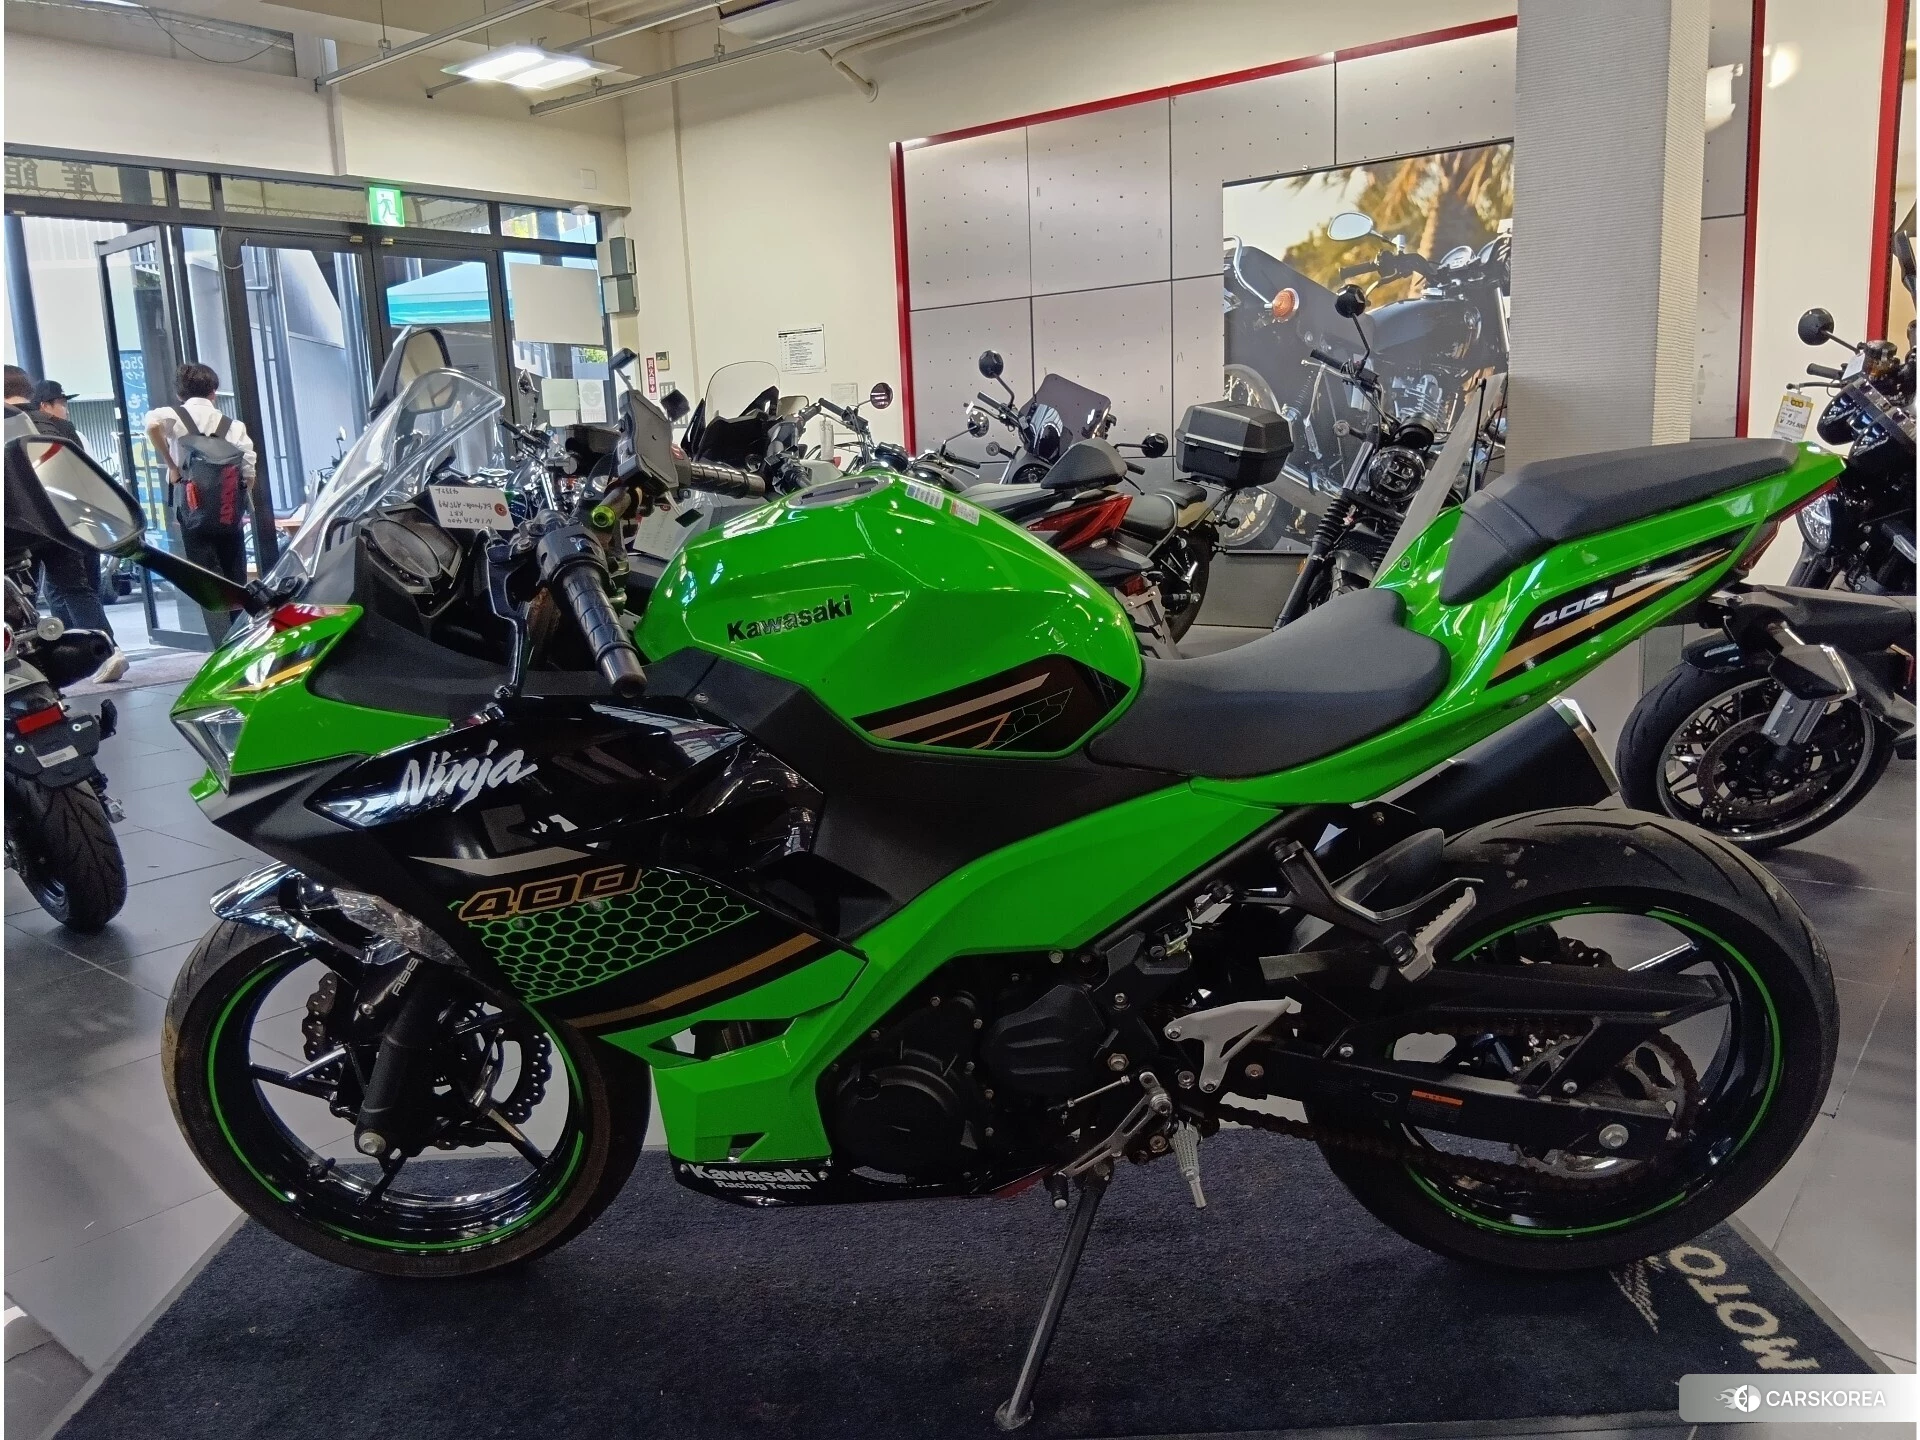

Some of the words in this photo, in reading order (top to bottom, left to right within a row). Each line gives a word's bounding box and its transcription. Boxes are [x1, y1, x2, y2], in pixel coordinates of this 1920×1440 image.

[727, 594, 852, 642] Kawasaki
[1533, 590, 1609, 630] 400
[396, 739, 538, 812] Ninja
[459, 863, 643, 921] 400
[392, 957, 419, 996] ABS
[688, 1163, 817, 1183] Kawasaki
[713, 1180, 768, 1191] Racing
[766, 1182, 811, 1190] Team
[1667, 1245, 1820, 1370] MOTO
